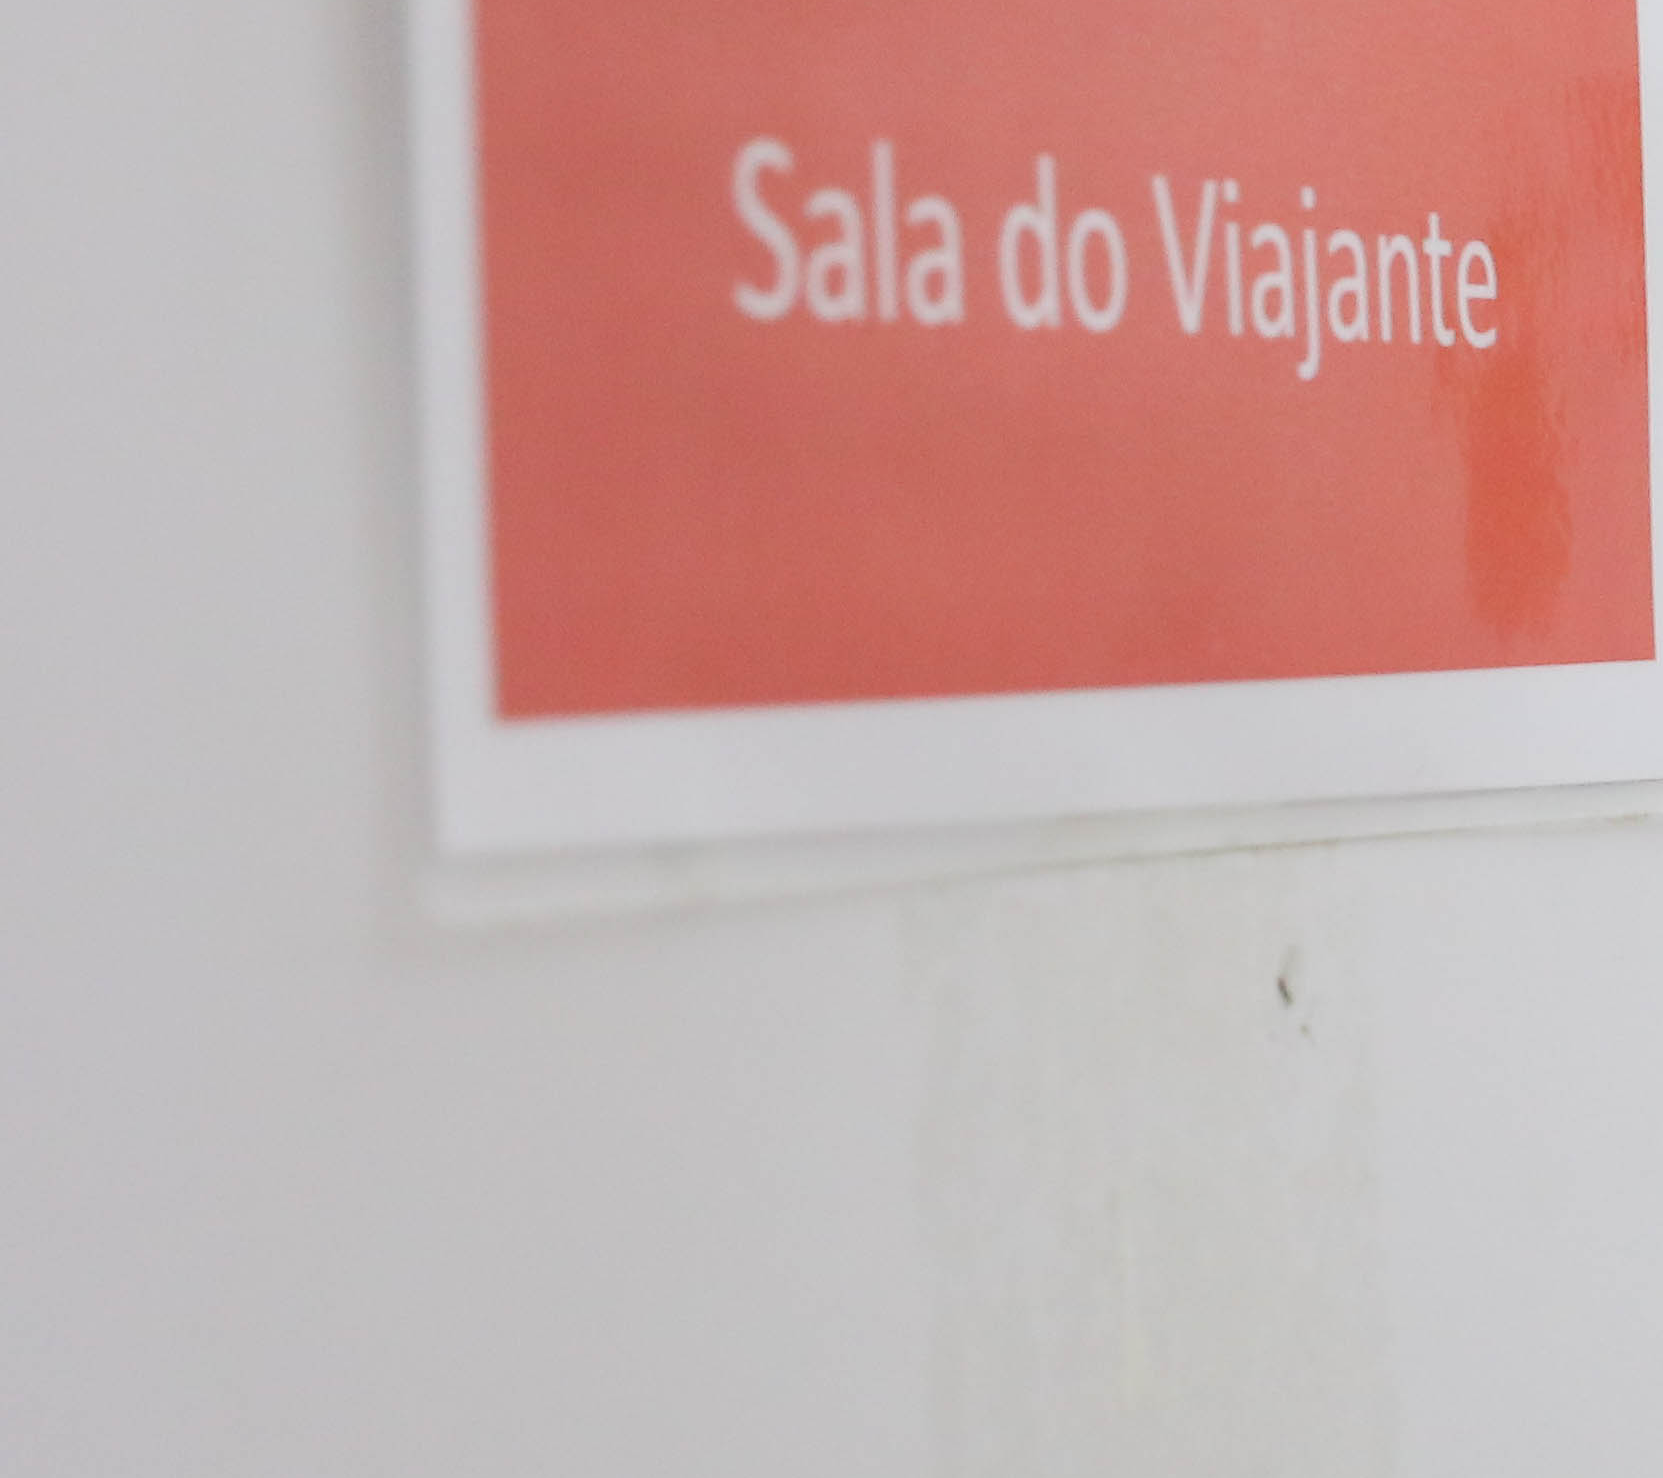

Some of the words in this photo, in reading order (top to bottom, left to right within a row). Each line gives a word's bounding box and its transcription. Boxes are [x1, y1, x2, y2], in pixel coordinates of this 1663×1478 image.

[732, 136, 965, 325] Sala
[998, 154, 1128, 333] do
[1150, 172, 1499, 382] Viajante
